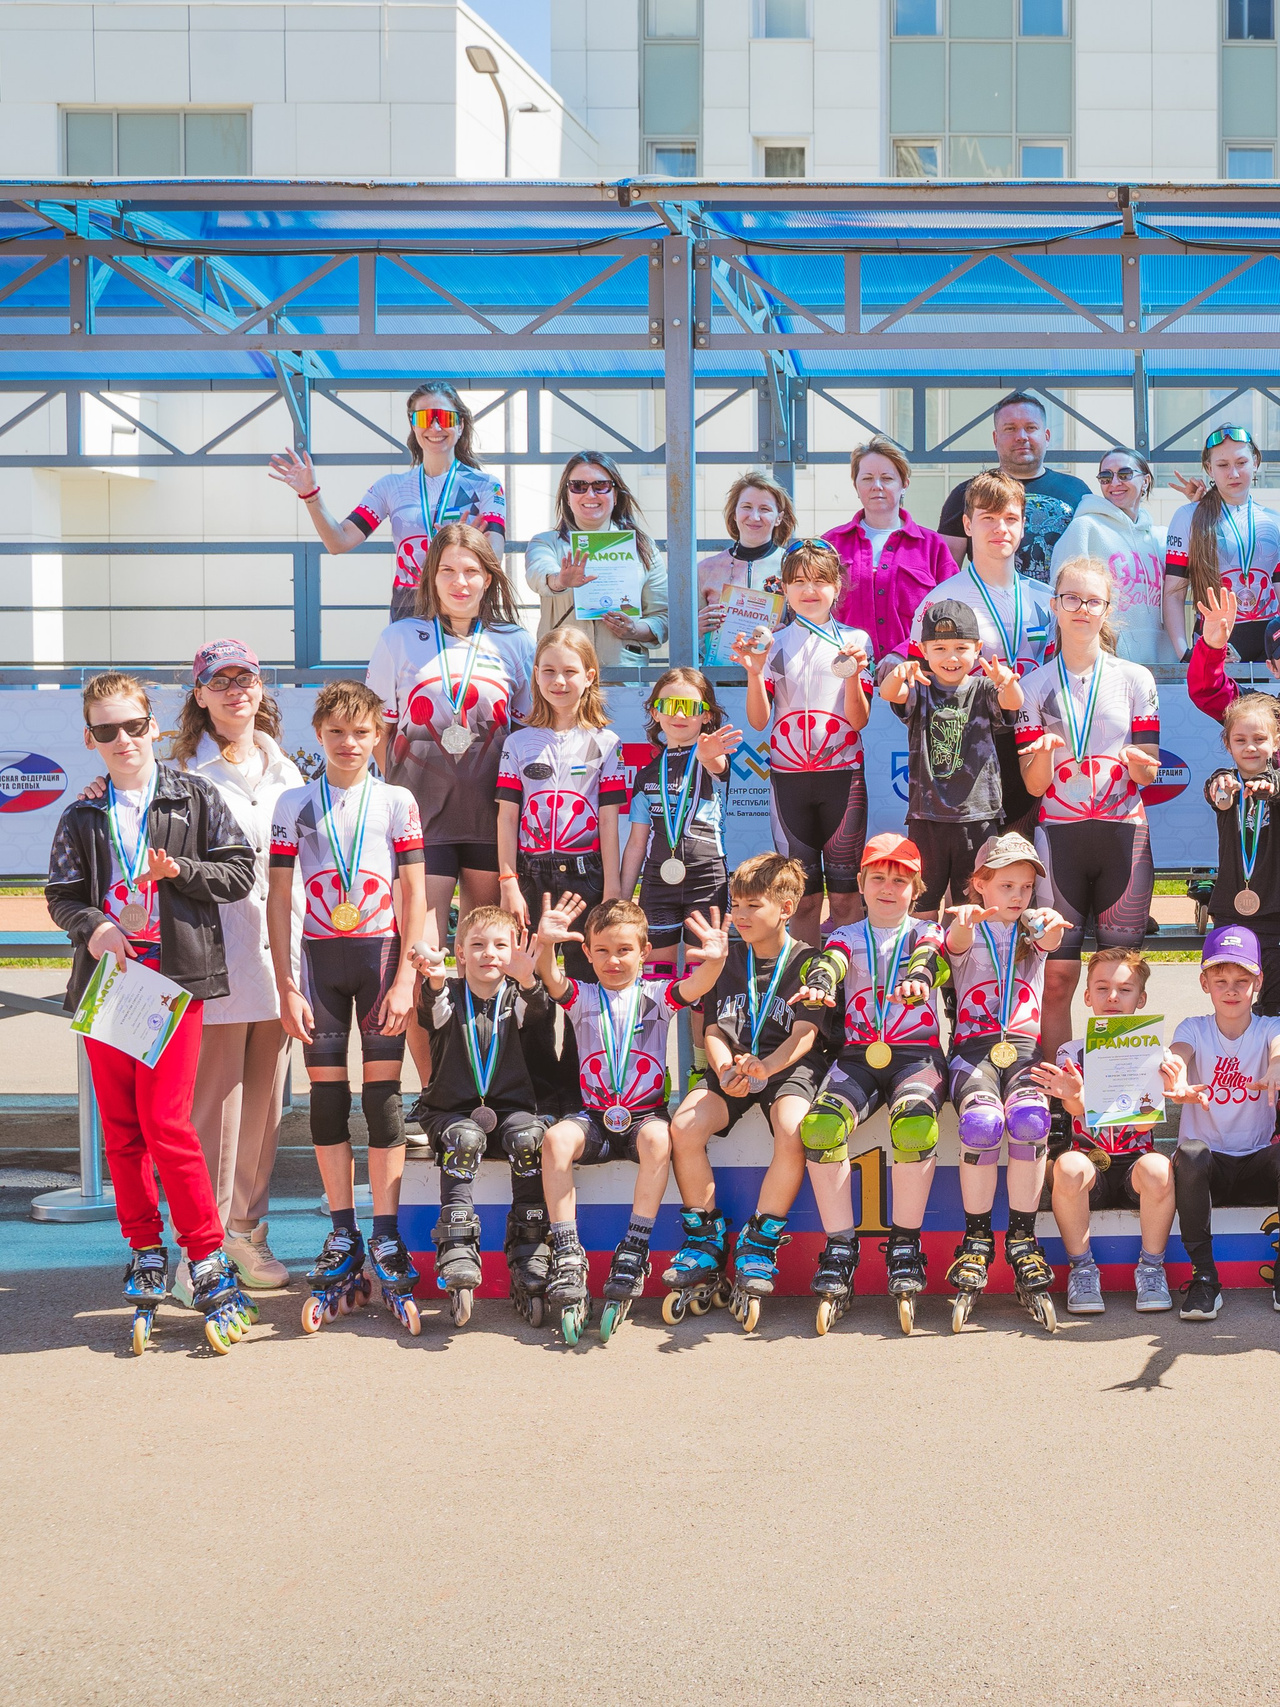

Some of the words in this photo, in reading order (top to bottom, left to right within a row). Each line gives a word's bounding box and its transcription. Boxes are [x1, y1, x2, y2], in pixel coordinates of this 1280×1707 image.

[727, 606, 769, 621] ГРАМОТА
[20, 774, 60, 782] ФЕДЕРАЦИЯ
[737, 810, 770, 818] Баталово
[1087, 1035, 1161, 1050] ГРАМОТА
